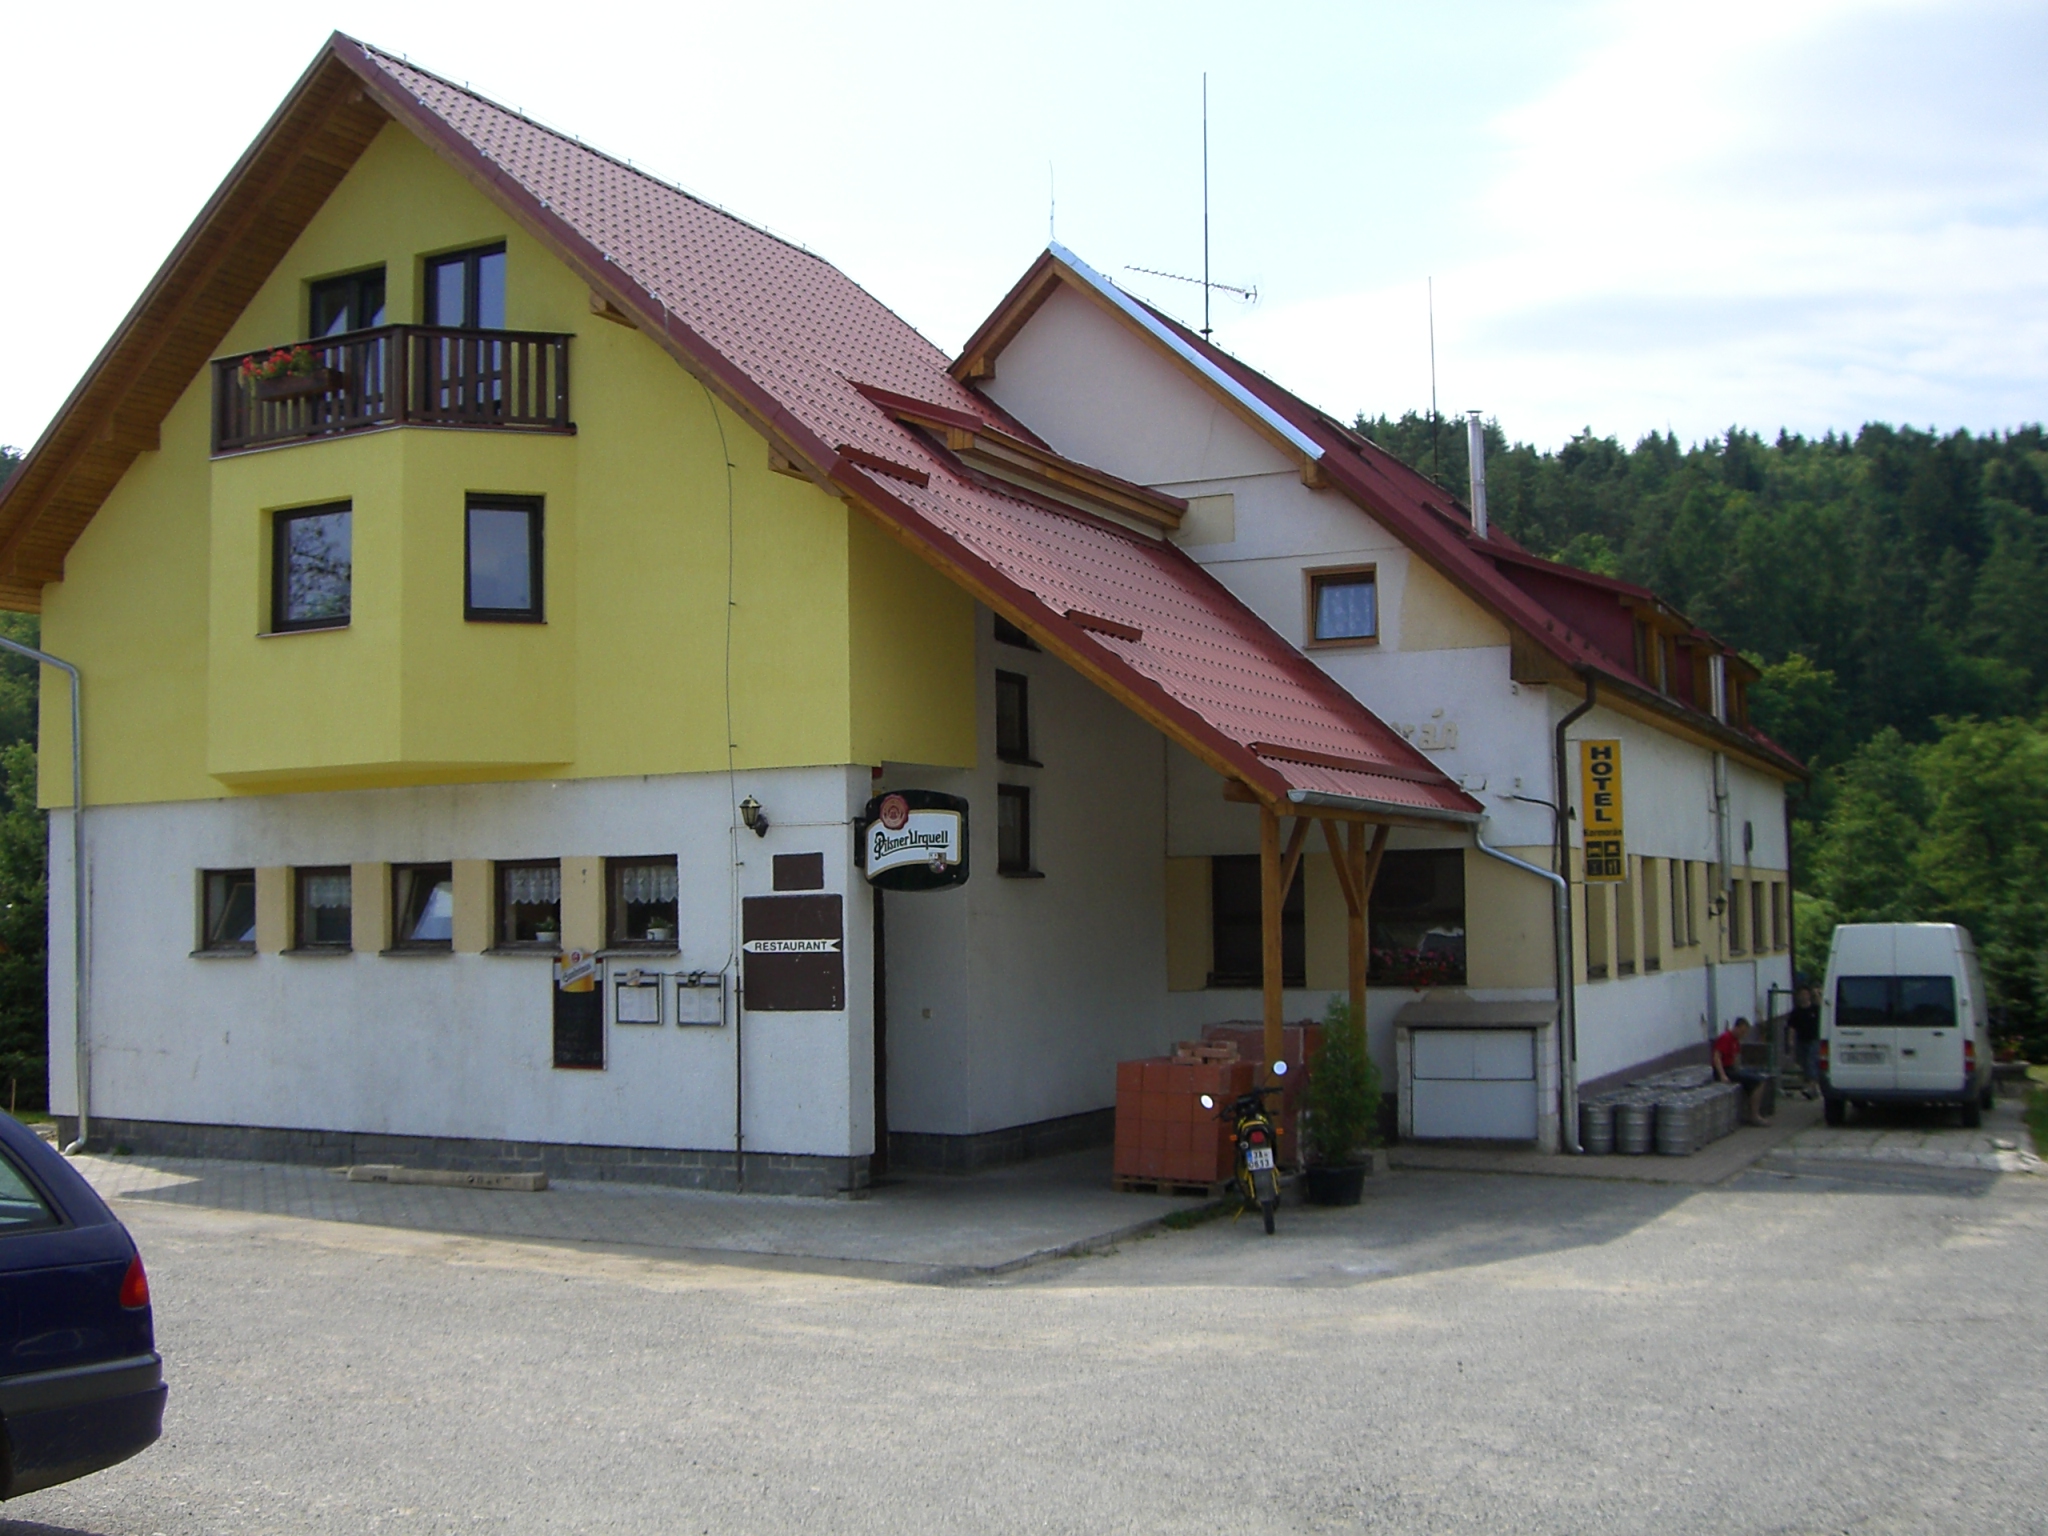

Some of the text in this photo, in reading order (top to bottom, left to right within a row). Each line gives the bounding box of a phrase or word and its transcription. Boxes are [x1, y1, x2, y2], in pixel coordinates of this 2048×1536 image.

[1590, 746, 1613, 822] HOTEL
[874, 829, 949, 861] Pilsner Urquell
[754, 941, 828, 952] RESTAURANT
